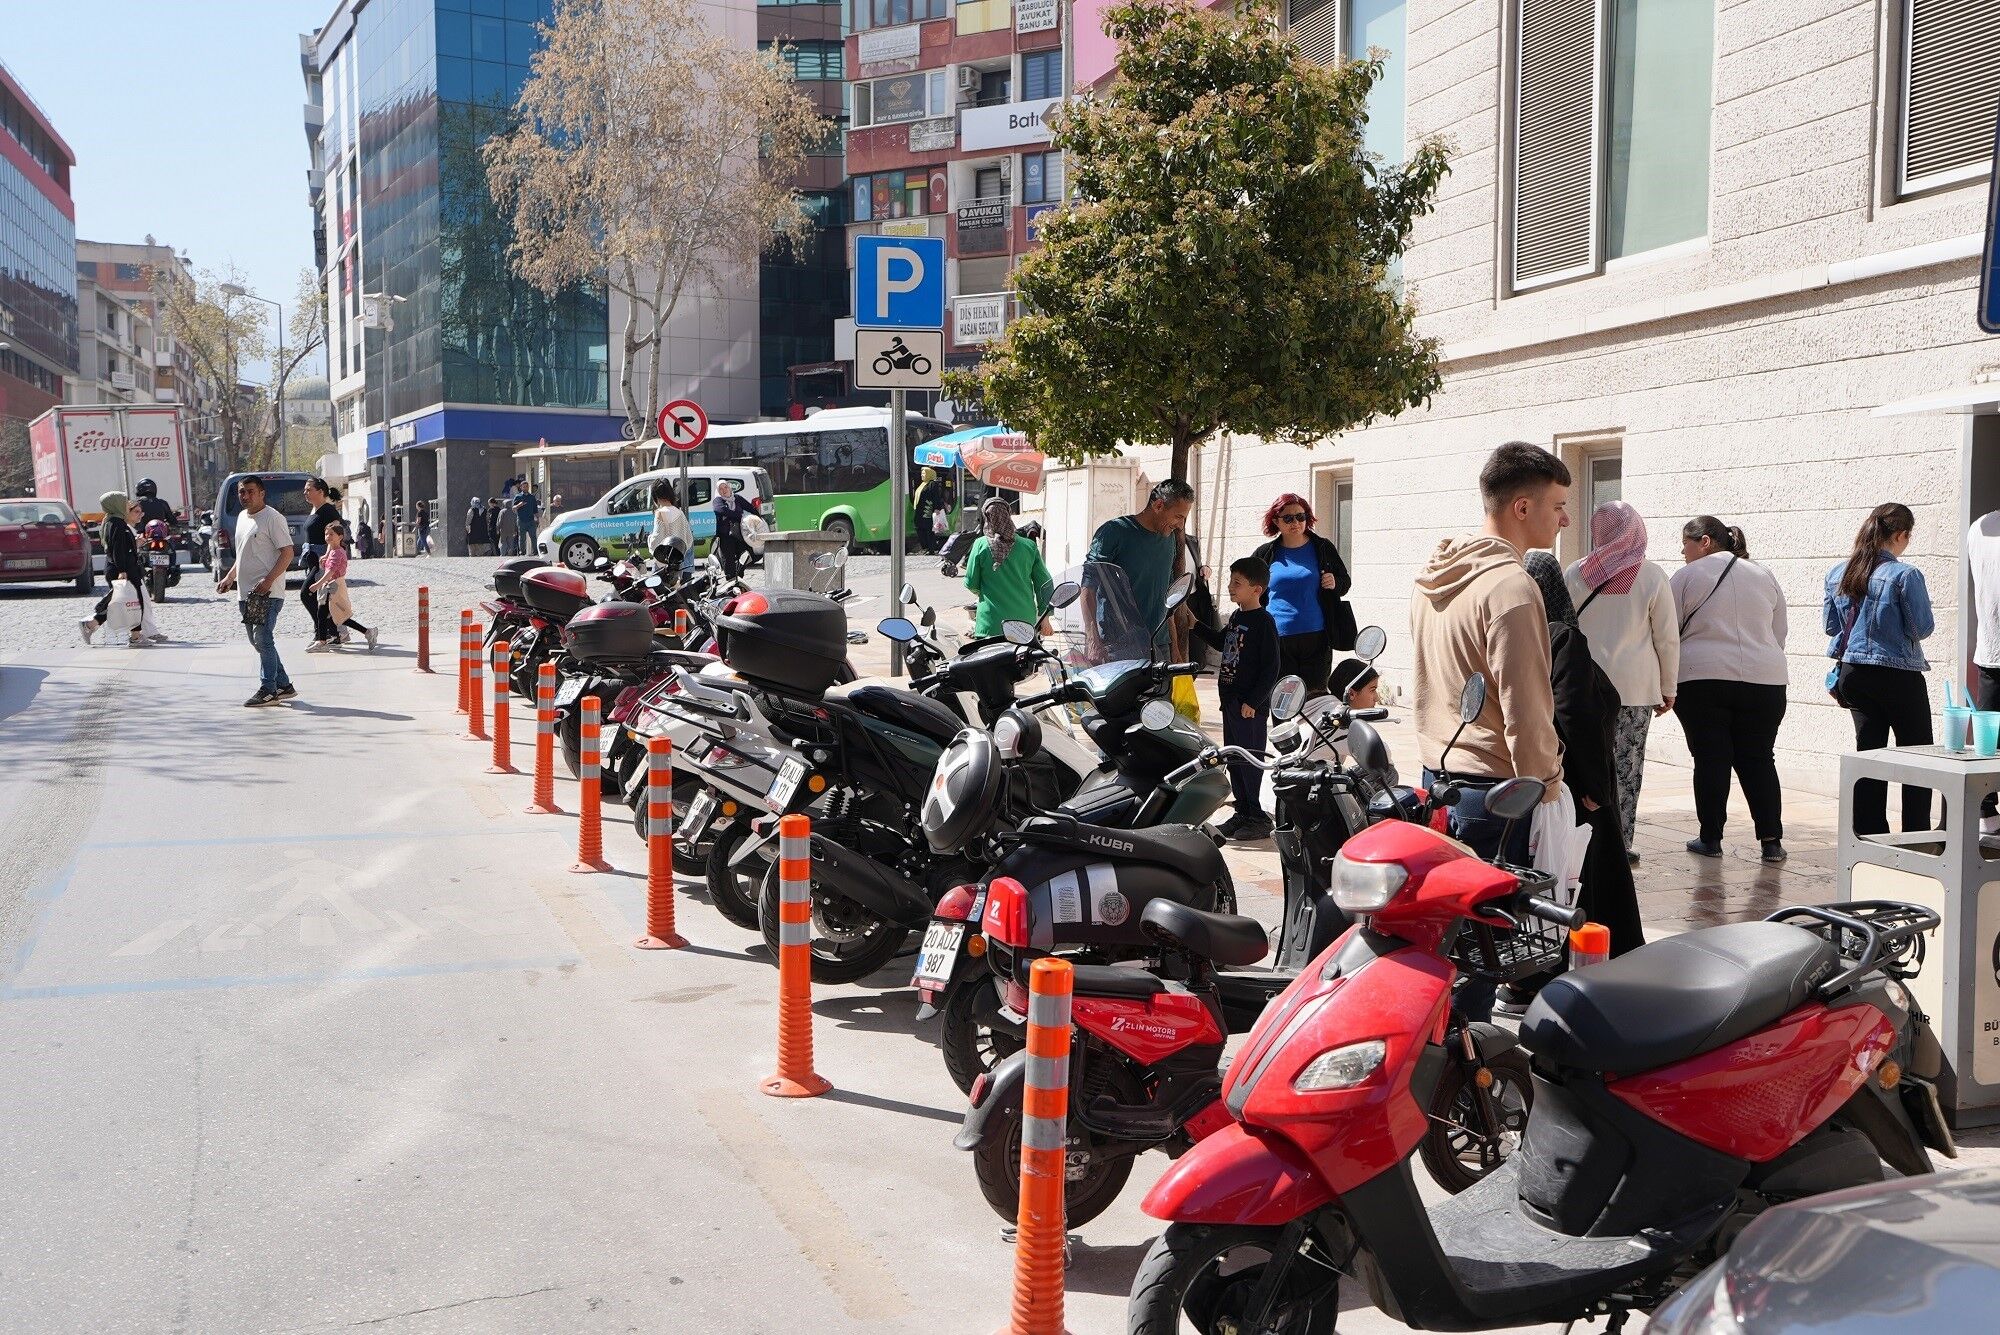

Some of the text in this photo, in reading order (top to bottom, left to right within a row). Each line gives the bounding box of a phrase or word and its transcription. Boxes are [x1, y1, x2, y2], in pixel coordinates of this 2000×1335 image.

[1021, 10, 1051, 20] AVUKAT
[1019, 19, 1053, 30] BANU AK
[1009, 112, 1039, 129] Batı
[968, 206, 1002, 217] AVUKAT
[876, 247, 924, 318] P
[960, 303, 999, 320] DİŞ HEKİMİ
[960, 322, 977, 336] HASAN
[780, 762, 792, 778] 20
[776, 782, 789, 800] 171
[1089, 834, 1134, 853] KUBA
[924, 929, 960, 951] 20 ADZ
[925, 953, 945, 973] 987
[1125, 1022, 1144, 1031] ZLIN
[1145, 1026, 1176, 1035] MOTORS
[1984, 1019, 2000, 1031] BÜ
